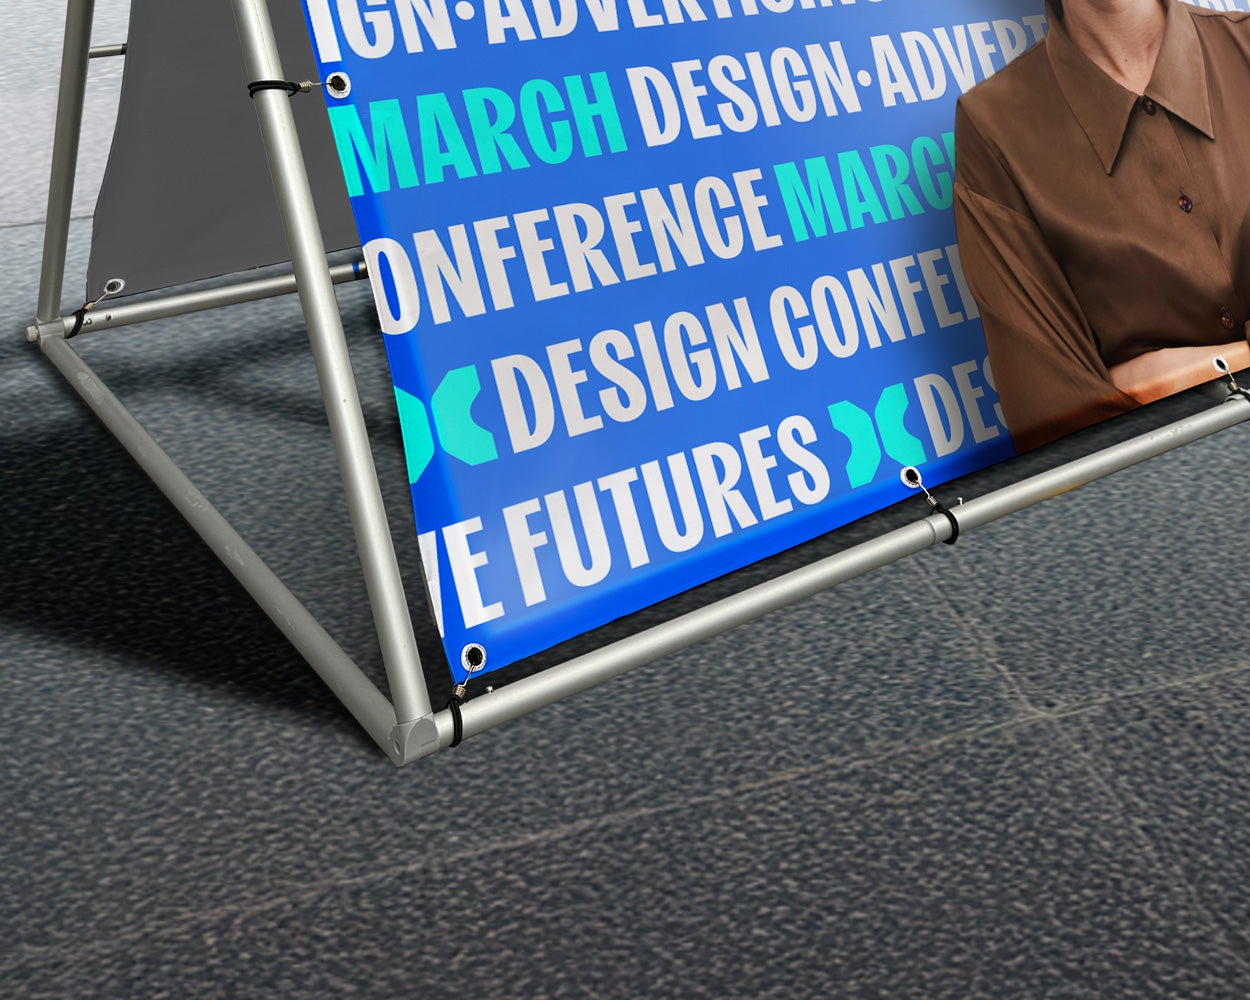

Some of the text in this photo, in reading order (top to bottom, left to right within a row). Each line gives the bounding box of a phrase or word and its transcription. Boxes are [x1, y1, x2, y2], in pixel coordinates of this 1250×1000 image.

[327, 71, 628, 198] MARCH
[362, 130, 957, 335] ONFERENCE MARC
[490, 297, 771, 455] DESIGN
[502, 414, 832, 608] FUTURES
